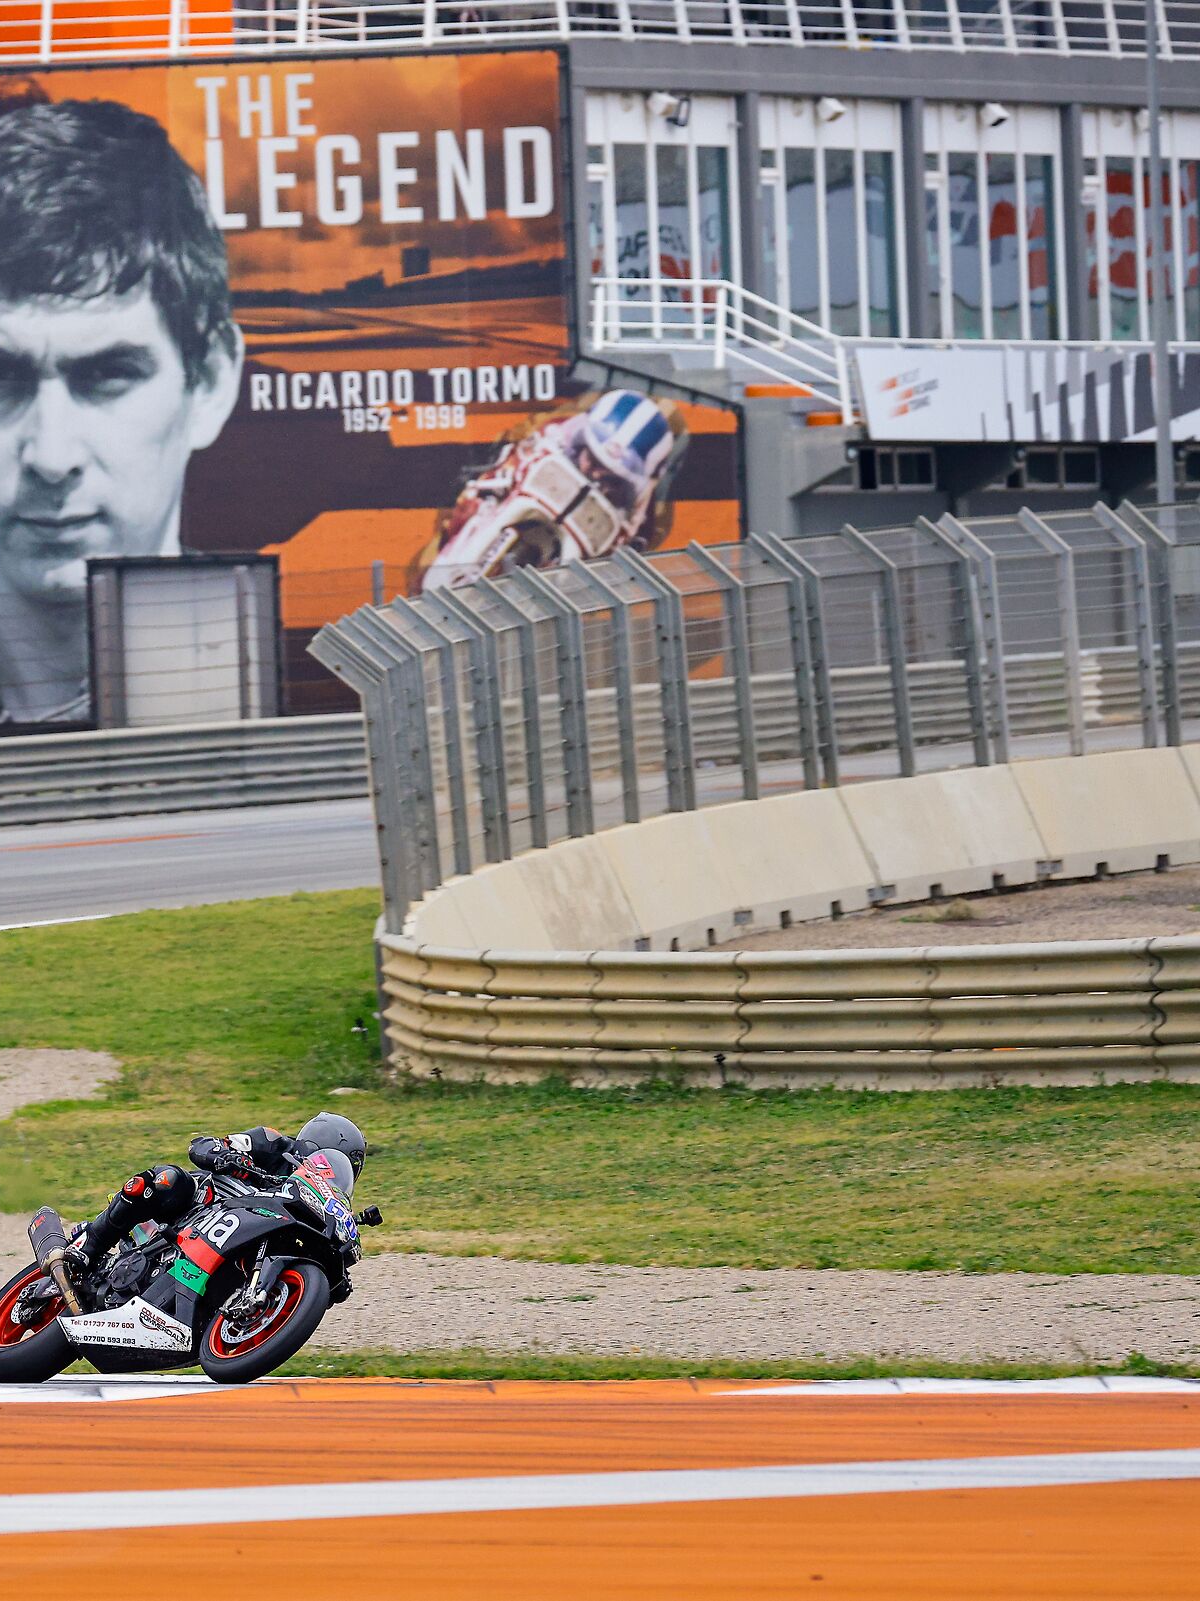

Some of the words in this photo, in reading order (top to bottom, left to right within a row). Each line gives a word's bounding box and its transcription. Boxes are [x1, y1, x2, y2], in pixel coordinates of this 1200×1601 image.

[195, 73, 317, 138] THE
[205, 126, 554, 229] LEGEND
[250, 369, 414, 411] RICARDO
[428, 363, 556, 404] TORMO
[342, 406, 392, 433] 1952
[415, 405, 466, 430] 1998
[83, 1320, 106, 1328] 01737
[140, 1312, 186, 1344] COMMERCIALS
[141, 1306, 167, 1326] COLLIER
